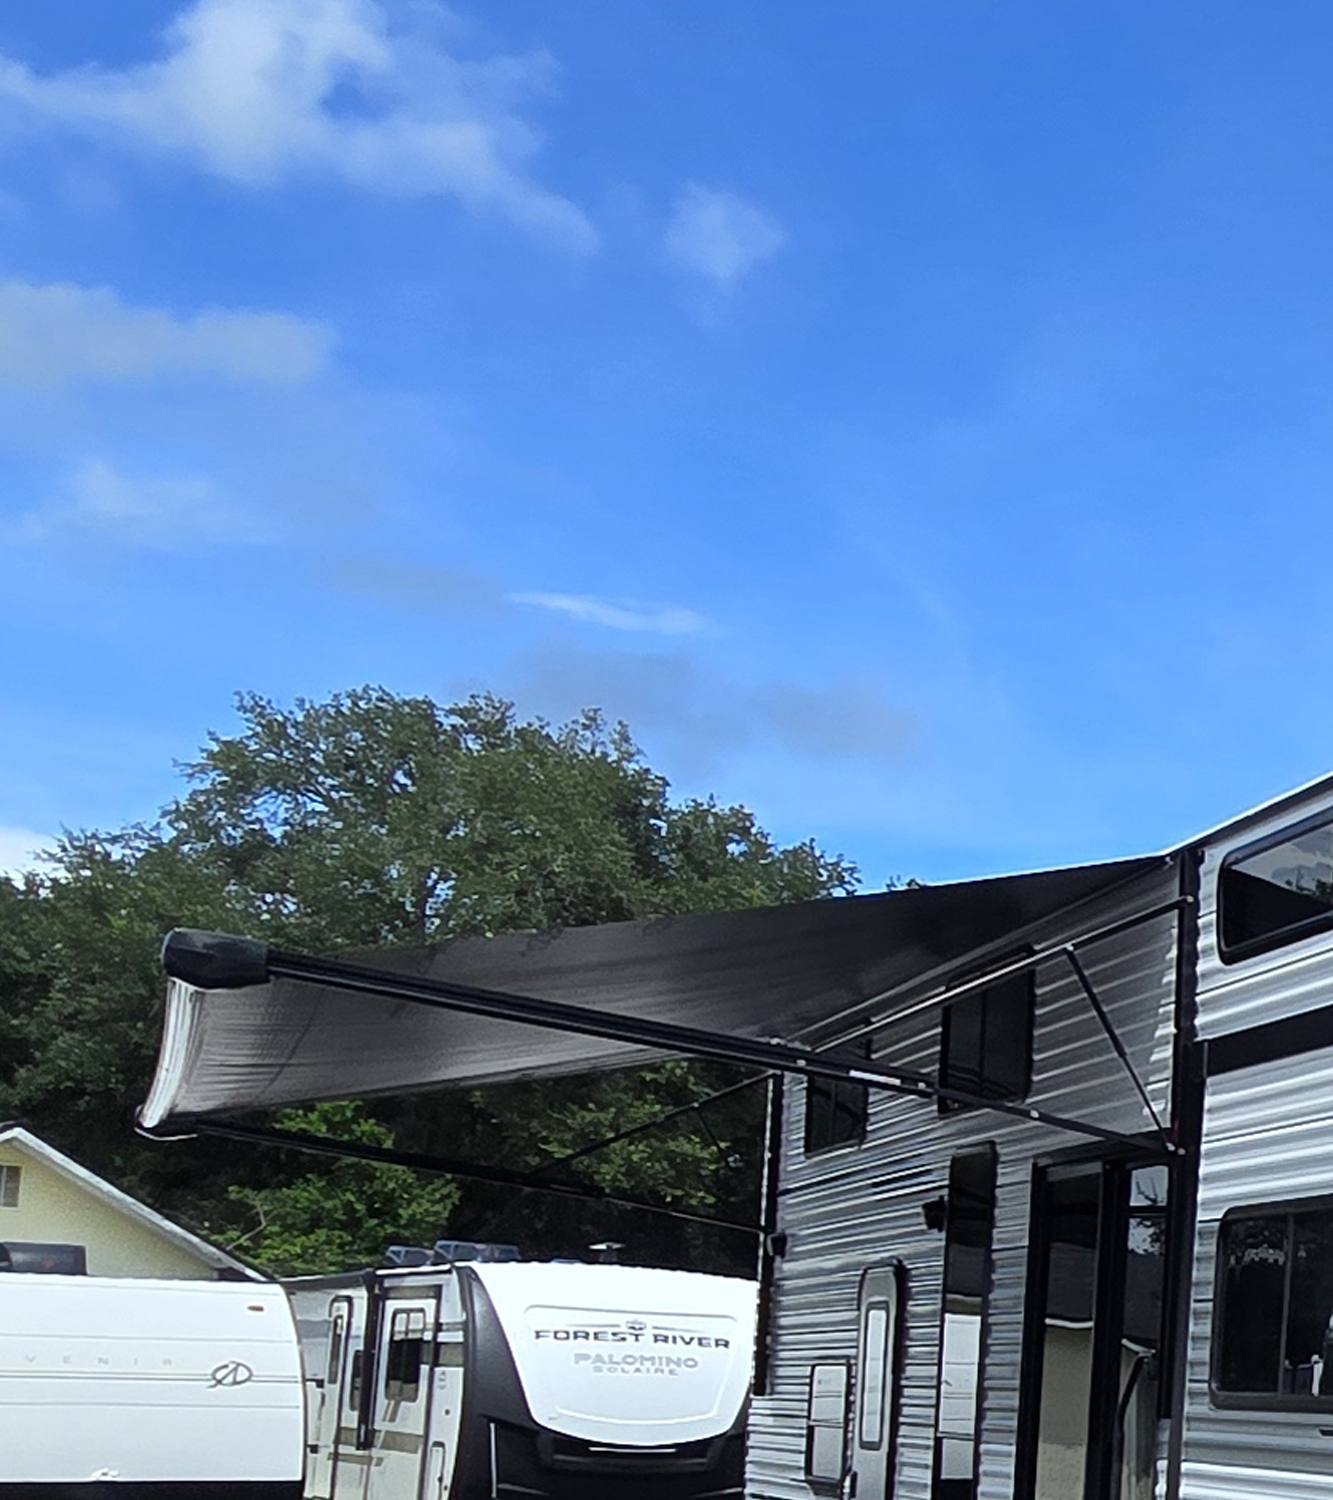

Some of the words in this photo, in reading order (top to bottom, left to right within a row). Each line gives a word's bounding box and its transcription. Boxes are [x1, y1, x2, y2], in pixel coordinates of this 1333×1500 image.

[534, 1329, 645, 1343] FOREST
[653, 1333, 730, 1349] RIVER
[574, 1352, 699, 1369] PALOMINO
[592, 1366, 679, 1377] SOLAIRE
